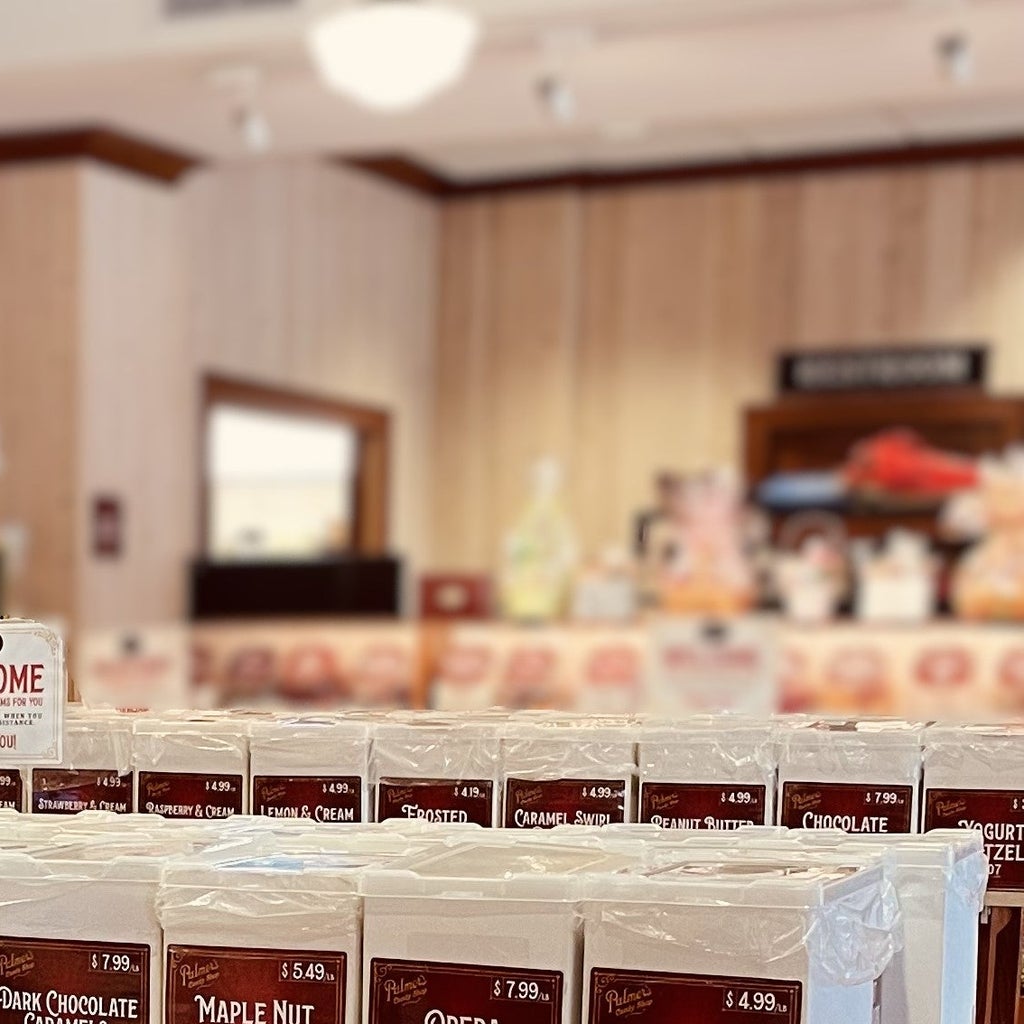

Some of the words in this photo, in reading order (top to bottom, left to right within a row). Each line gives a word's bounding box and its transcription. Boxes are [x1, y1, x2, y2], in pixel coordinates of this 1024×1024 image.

[12, 697, 27, 707] FOR
[29, 697, 43, 707] YOU
[38, 798, 88, 811] STRAWBERRY
[99, 800, 127, 812] CREAM
[145, 802, 193, 815] RASPBERRY
[195, 804, 203, 817] &
[205, 805, 235, 818] CREAM
[260, 805, 298, 818] LEMON
[301, 805, 311, 818] &
[314, 805, 354, 823] CREAM
[401, 804, 468, 823] FROSTED
[514, 809, 567, 827] CARAMEL
[574, 810, 610, 826] SWIRL
[651, 815, 702, 830] PEANUT
[802, 811, 889, 832] CHOCOLATE
[46, 990, 138, 1019] CHOCOLATE
[194, 995, 267, 1024] MAPLE
